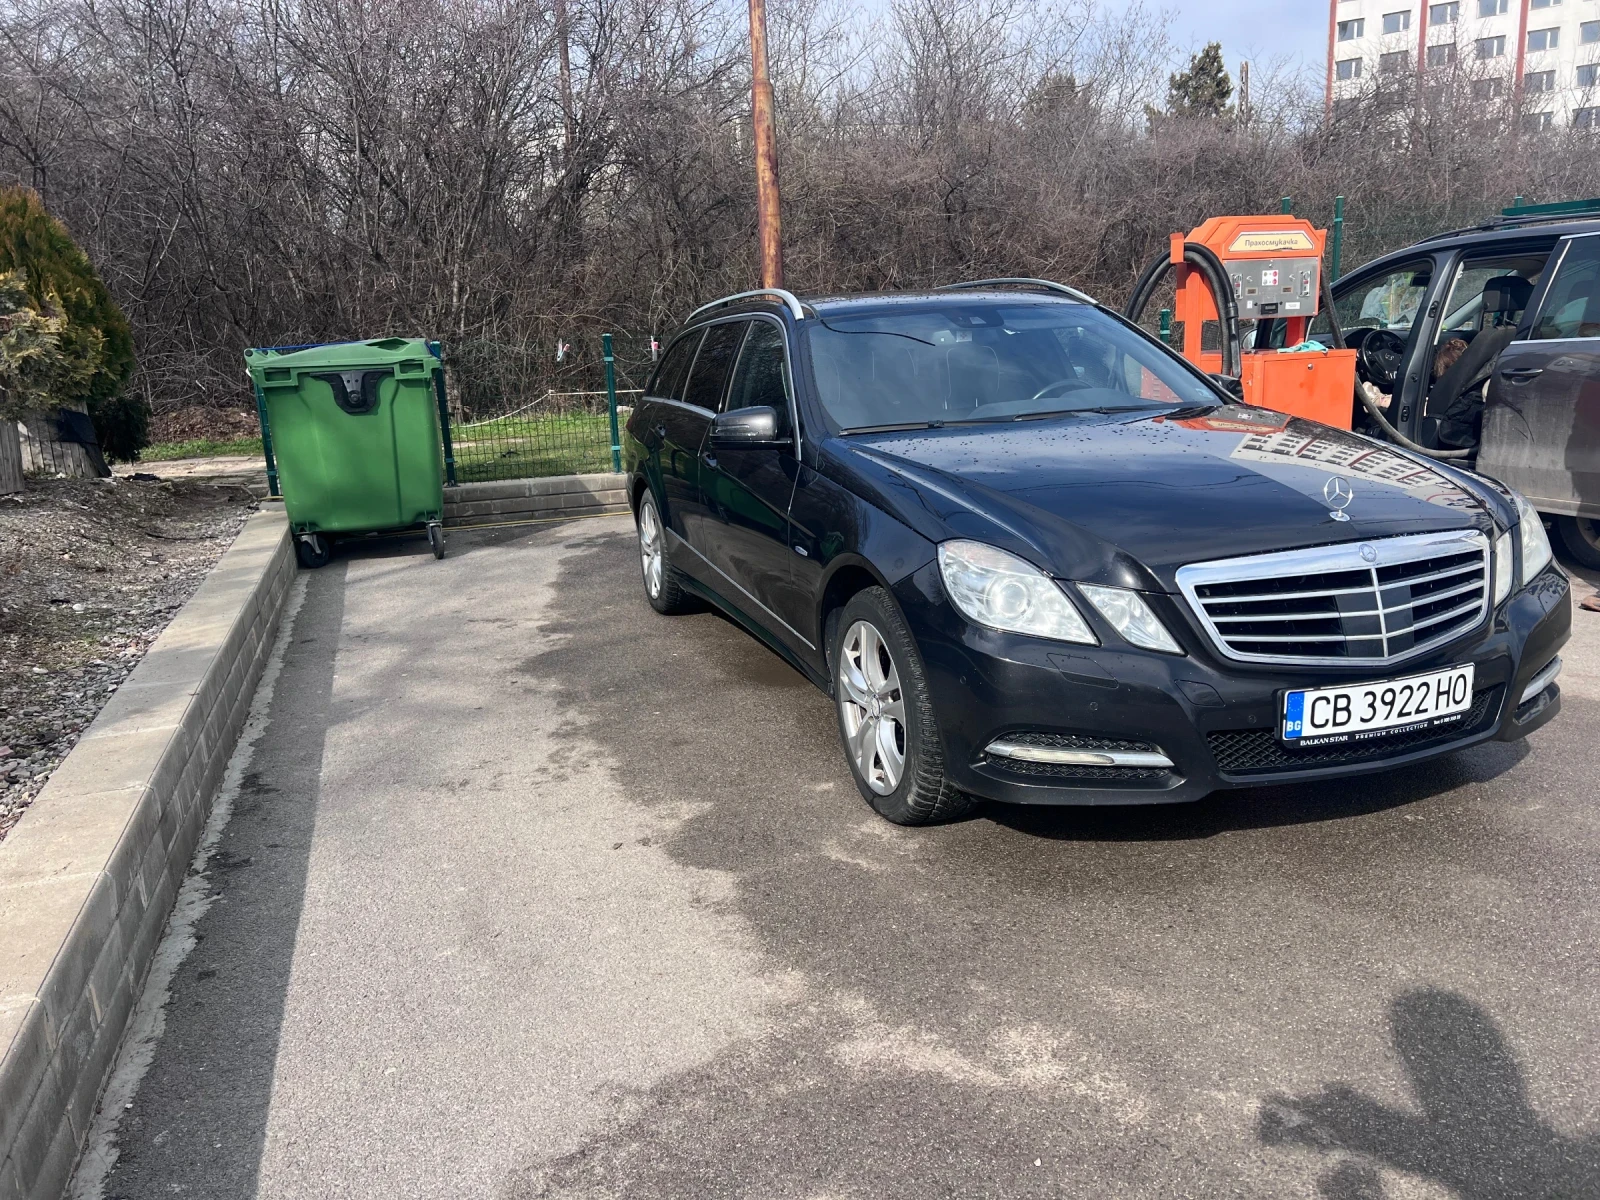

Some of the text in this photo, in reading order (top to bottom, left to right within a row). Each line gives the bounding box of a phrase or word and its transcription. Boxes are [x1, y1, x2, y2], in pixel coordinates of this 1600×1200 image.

[1245, 239, 1298, 247] Прахосмукачка
[1310, 673, 1467, 729] CB 3922 HO
[1286, 720, 1301, 731] BG
[1300, 723, 1428, 746] BALKAN STAR PREMIUM COLLECTION
